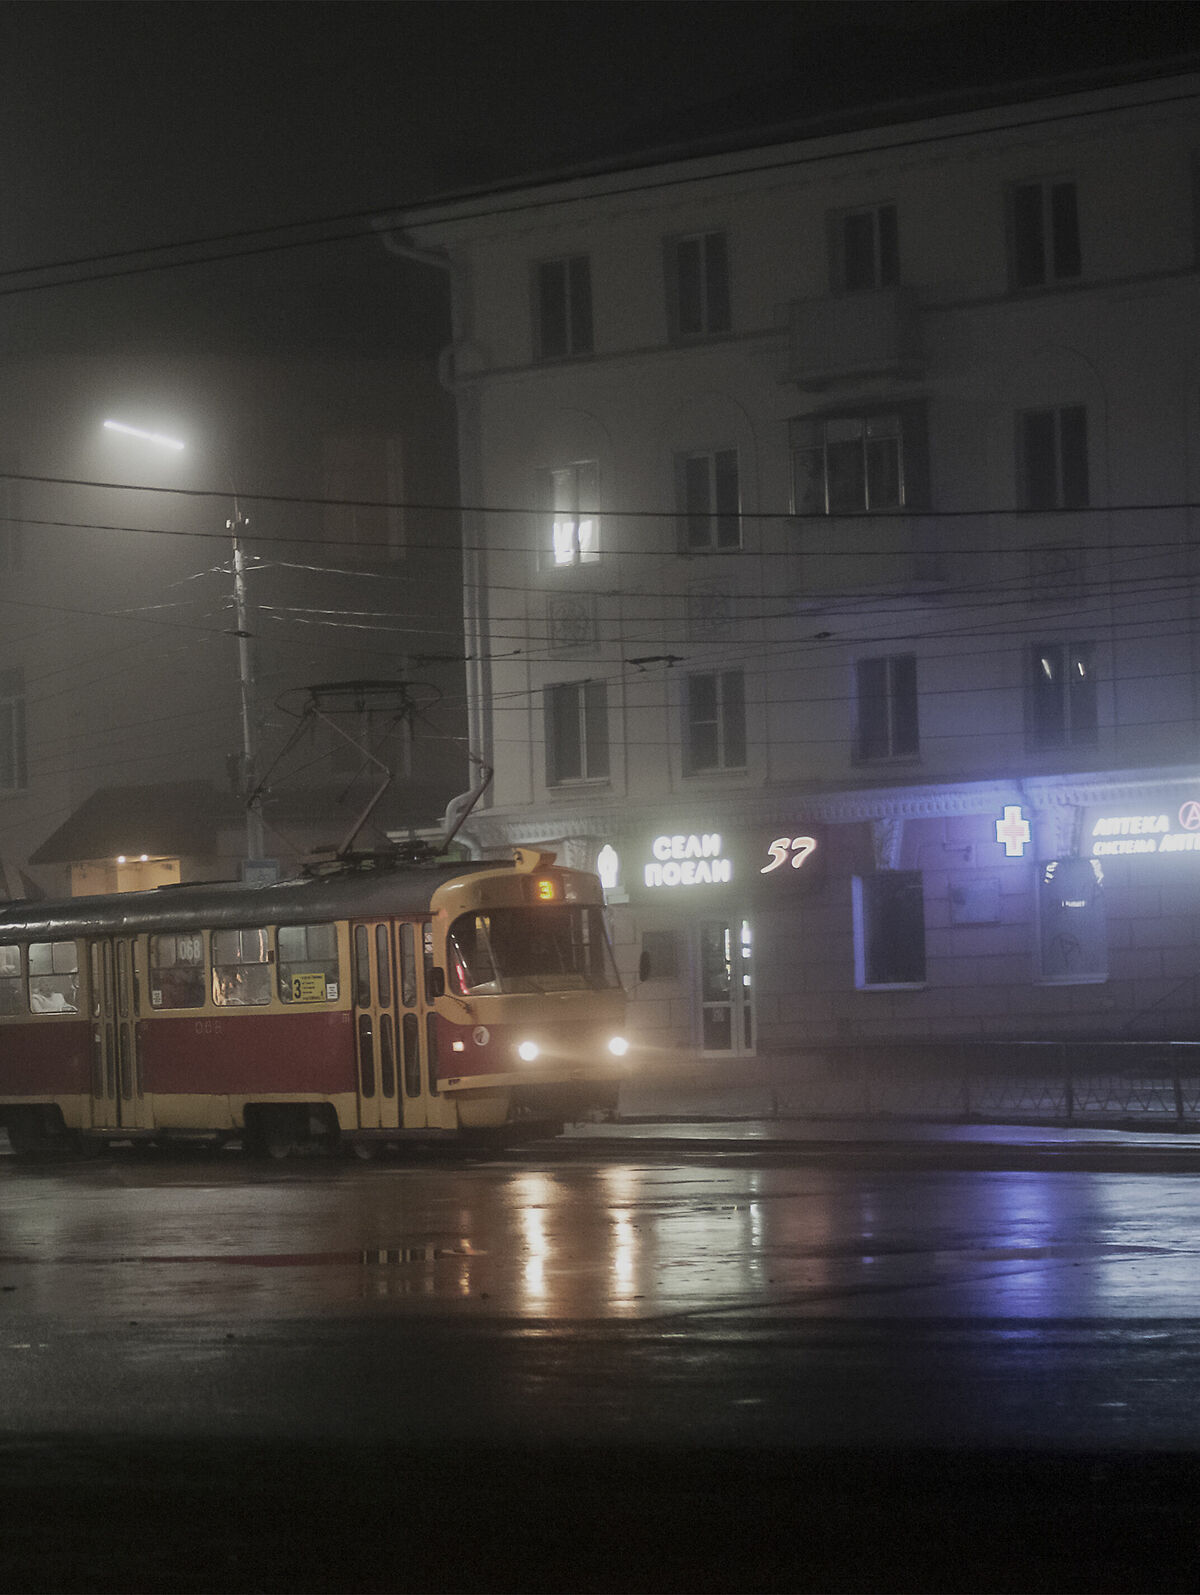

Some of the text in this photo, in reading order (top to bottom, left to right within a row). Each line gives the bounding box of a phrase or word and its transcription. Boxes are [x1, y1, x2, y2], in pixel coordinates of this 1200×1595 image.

[1092, 815, 1170, 836] АПТЕКА
[652, 833, 722, 860] СЕЛИ
[760, 836, 817, 874] 57
[644, 859, 732, 887] ПОЕЛИ
[538, 880, 553, 900] 3
[179, 939, 200, 960] 068
[293, 978, 302, 999] 3
